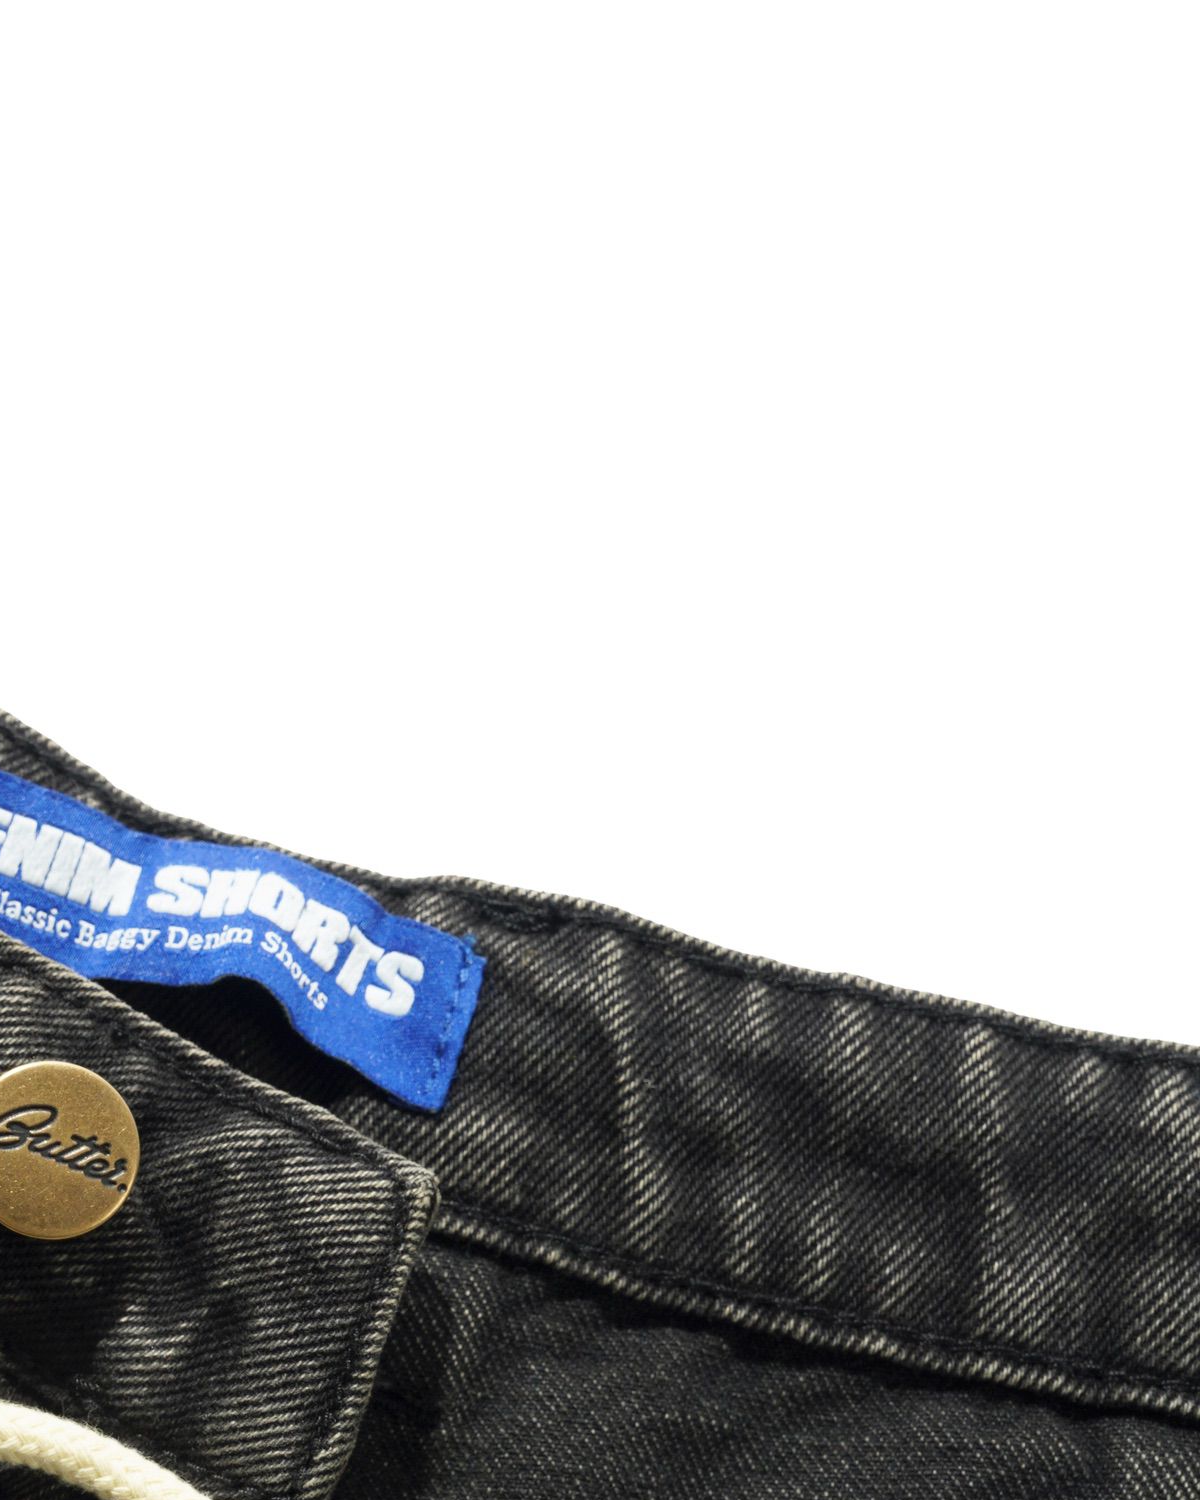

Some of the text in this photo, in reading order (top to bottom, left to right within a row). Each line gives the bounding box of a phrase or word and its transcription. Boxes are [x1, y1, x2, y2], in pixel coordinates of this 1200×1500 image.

[75, 920, 161, 952] Baggy
[164, 924, 253, 951] Denim
[260, 930, 329, 1011] Shorts
[146, 864, 424, 1017] SHORTS
